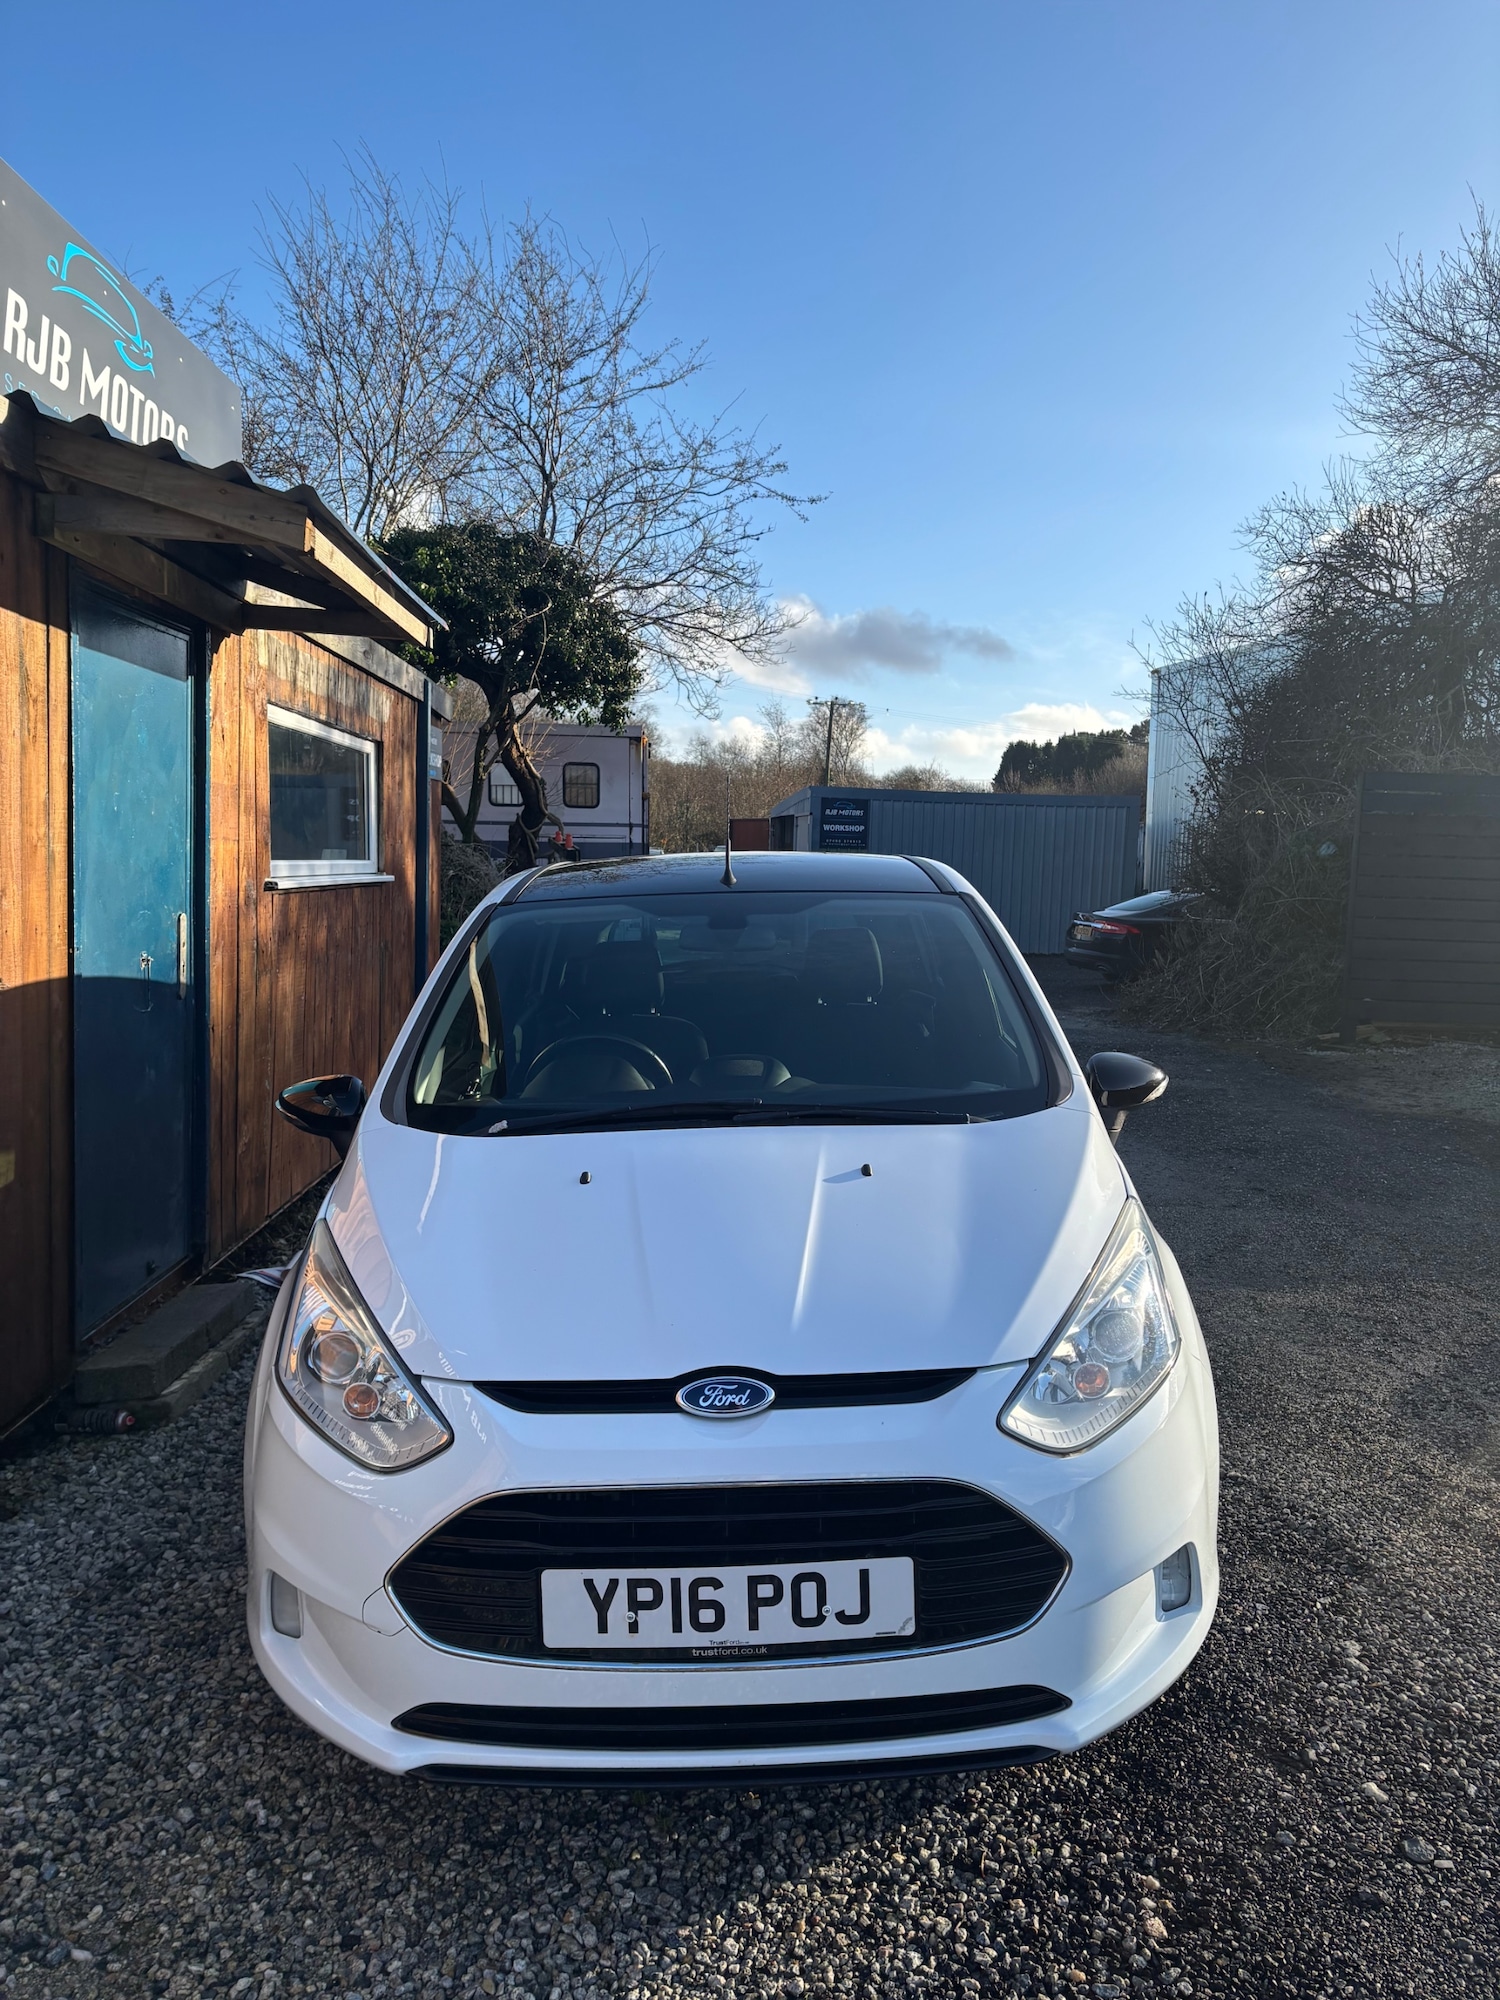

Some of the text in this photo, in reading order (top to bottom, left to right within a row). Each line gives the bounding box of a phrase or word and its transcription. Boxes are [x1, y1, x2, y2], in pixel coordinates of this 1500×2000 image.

[3, 287, 72, 391] RJB
[823, 824, 865, 832] WORKSHOP
[699, 1384, 751, 1407] Ford
[583, 1568, 871, 1635] YP16 POJ
[692, 1646, 768, 1657] trustford.co.uk
